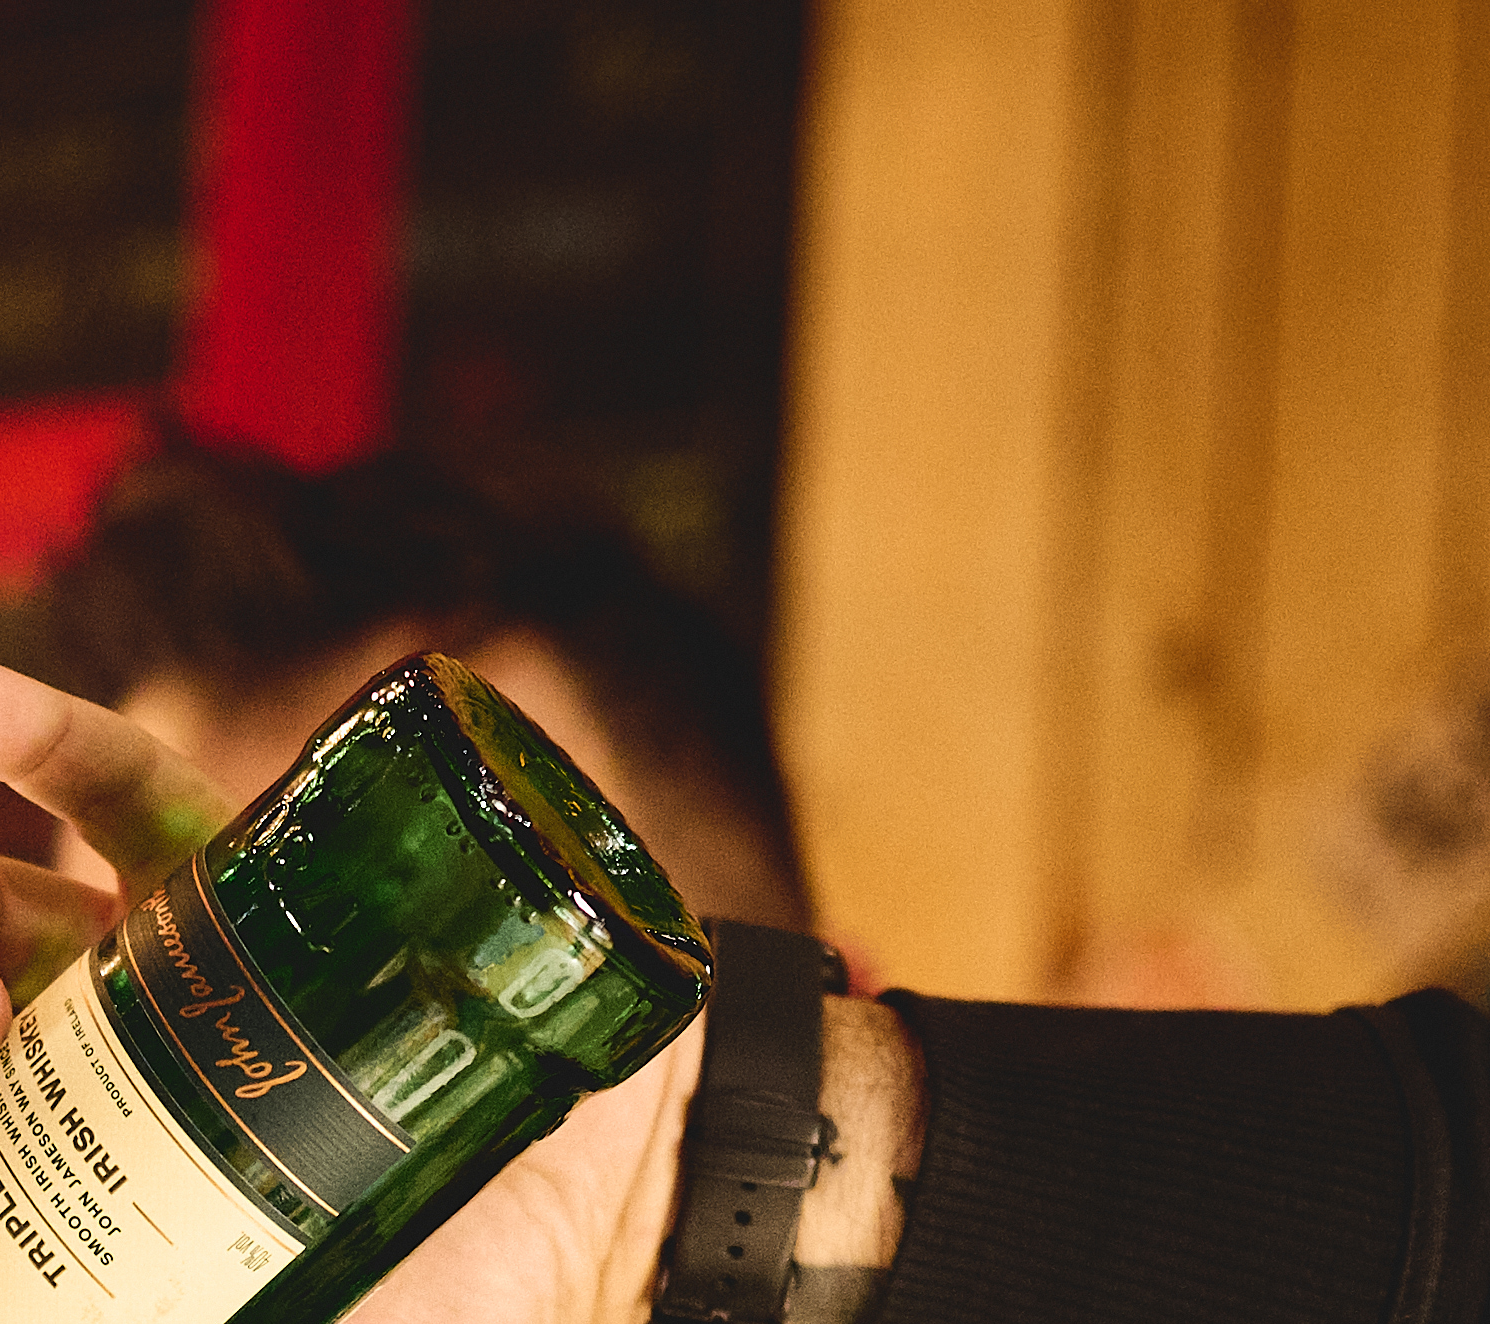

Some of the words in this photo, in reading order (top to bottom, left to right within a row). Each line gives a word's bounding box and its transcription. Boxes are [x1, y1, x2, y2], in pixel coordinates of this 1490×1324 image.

[63, 997, 86, 1041] IRELAND
[19, 1008, 67, 1111] WHISKEY
[80, 1042, 95, 1058] OF
[215, 1011, 308, 1099] John
[8, 1080, 30, 1113] WAY
[90, 1059, 133, 1118] PRODUCT
[18, 1144, 53, 1192] IRISH
[25, 1110, 82, 1189] JAMESON
[58, 1107, 128, 1195] IRISH
[50, 1192, 114, 1266] SMOOTH
[78, 1191, 122, 1236] JOHN
[240, 1244, 272, 1273] 40%
